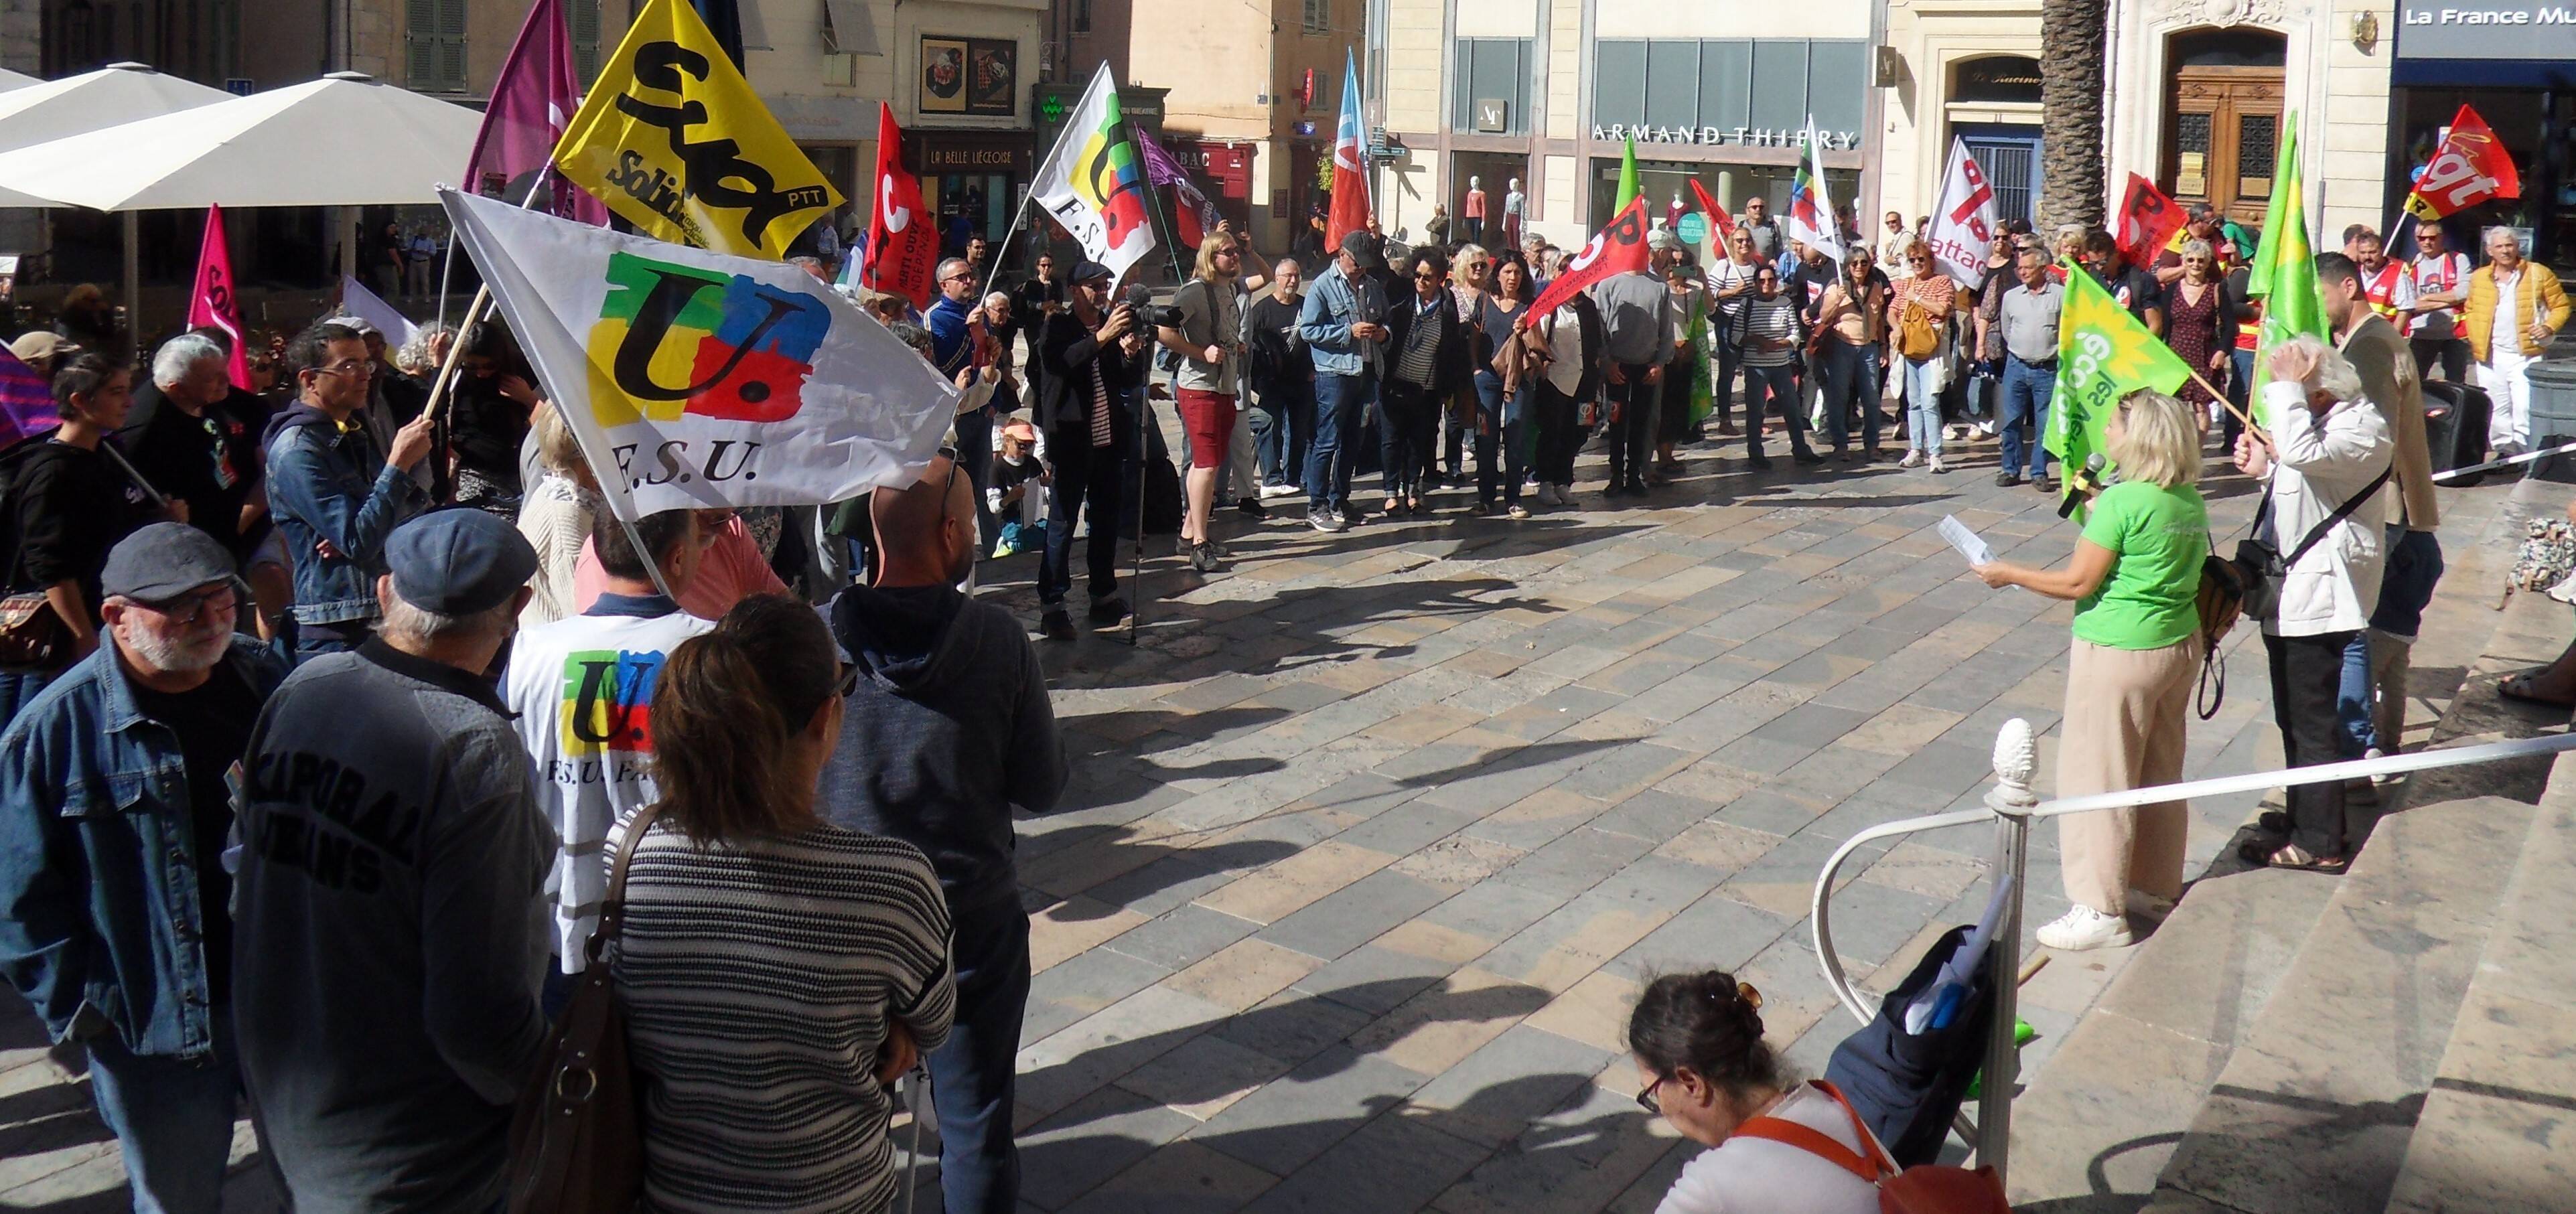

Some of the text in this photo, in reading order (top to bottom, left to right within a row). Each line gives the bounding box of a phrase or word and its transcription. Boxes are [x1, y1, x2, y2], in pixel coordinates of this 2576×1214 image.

[2405, 9, 2433, 25] La
[2441, 9, 2529, 25] France
[1592, 124, 1721, 144] ARMAND
[930, 151, 940, 164] LA
[945, 151, 967, 164] BELLE
[788, 189, 821, 208] PTT
[1931, 238, 1988, 277] attac
